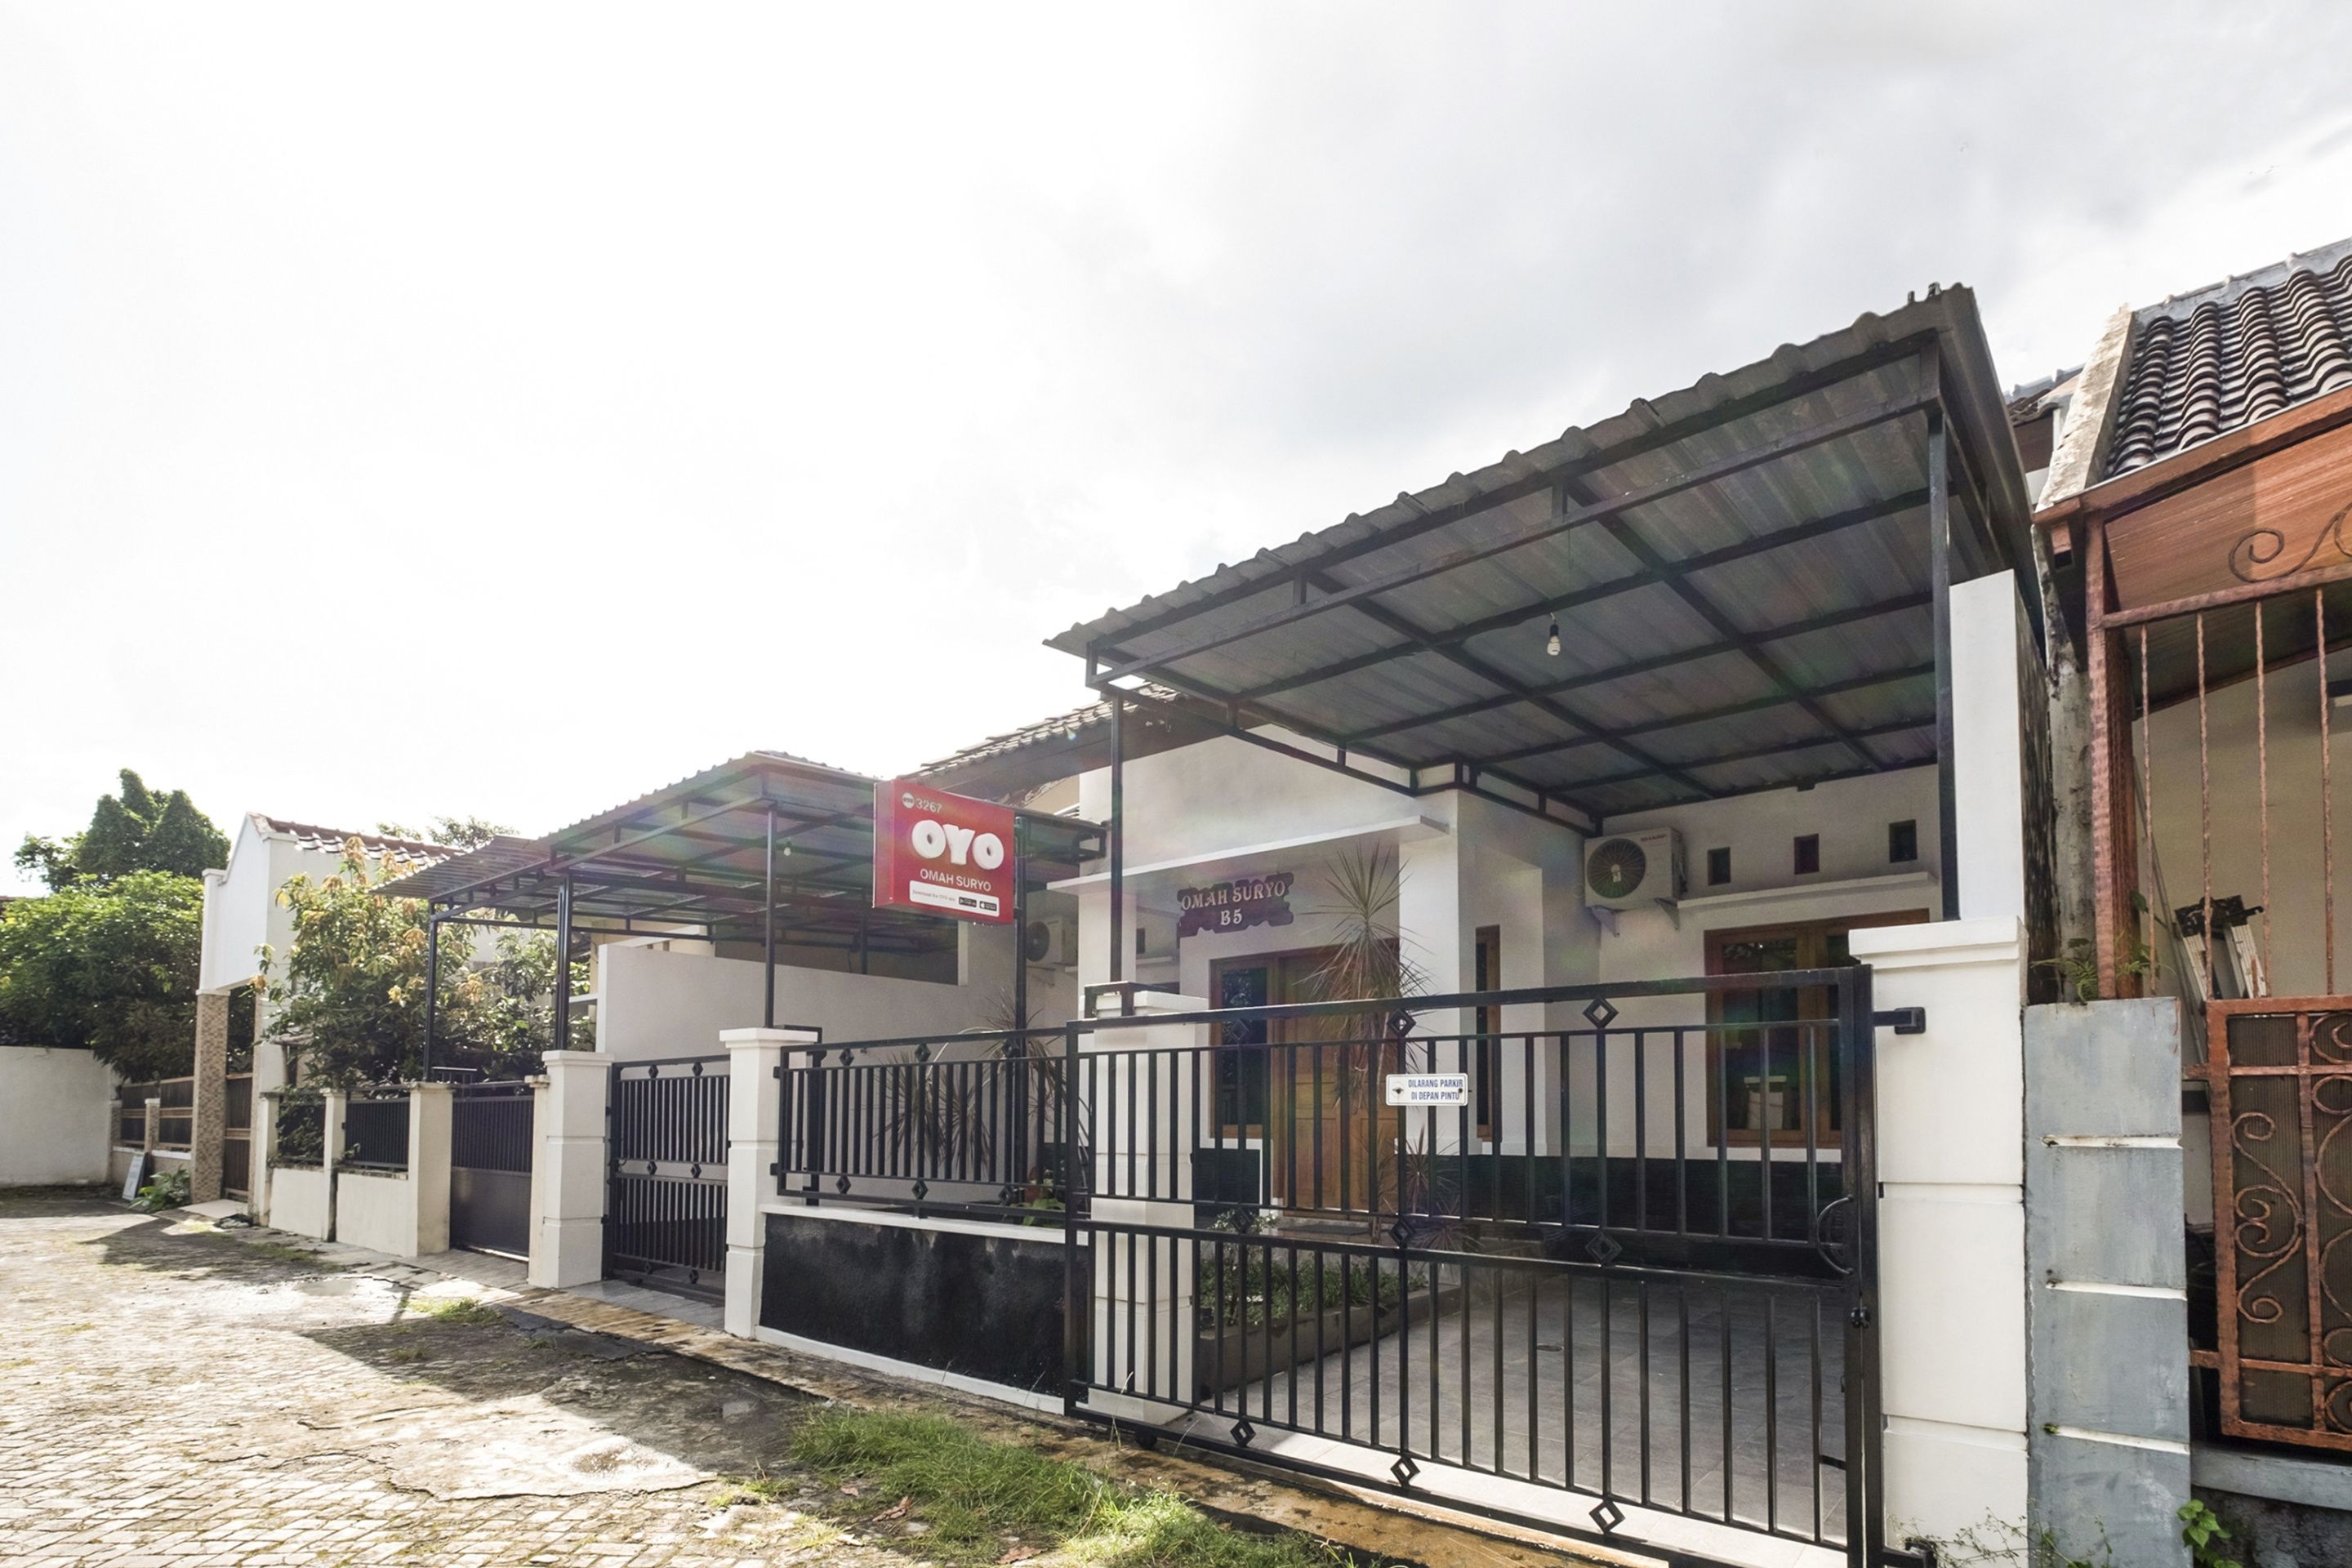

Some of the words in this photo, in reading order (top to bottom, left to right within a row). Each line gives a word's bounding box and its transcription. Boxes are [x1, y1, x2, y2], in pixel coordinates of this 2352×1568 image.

[915, 798, 942, 813] 3267
[911, 819, 1004, 870] OYO
[920, 868, 954, 884] OMAH
[956, 876, 991, 892] SURYO
[1182, 889, 1227, 911] OMAH
[1232, 880, 1285, 902] SURYO
[1408, 1079, 1438, 1088] DILARANG
[1440, 1079, 1463, 1088] PARKIR
[1411, 1091, 1418, 1100] DI
[1419, 1091, 1439, 1100] DEPAN
[1441, 1091, 1459, 1100] PINTU
